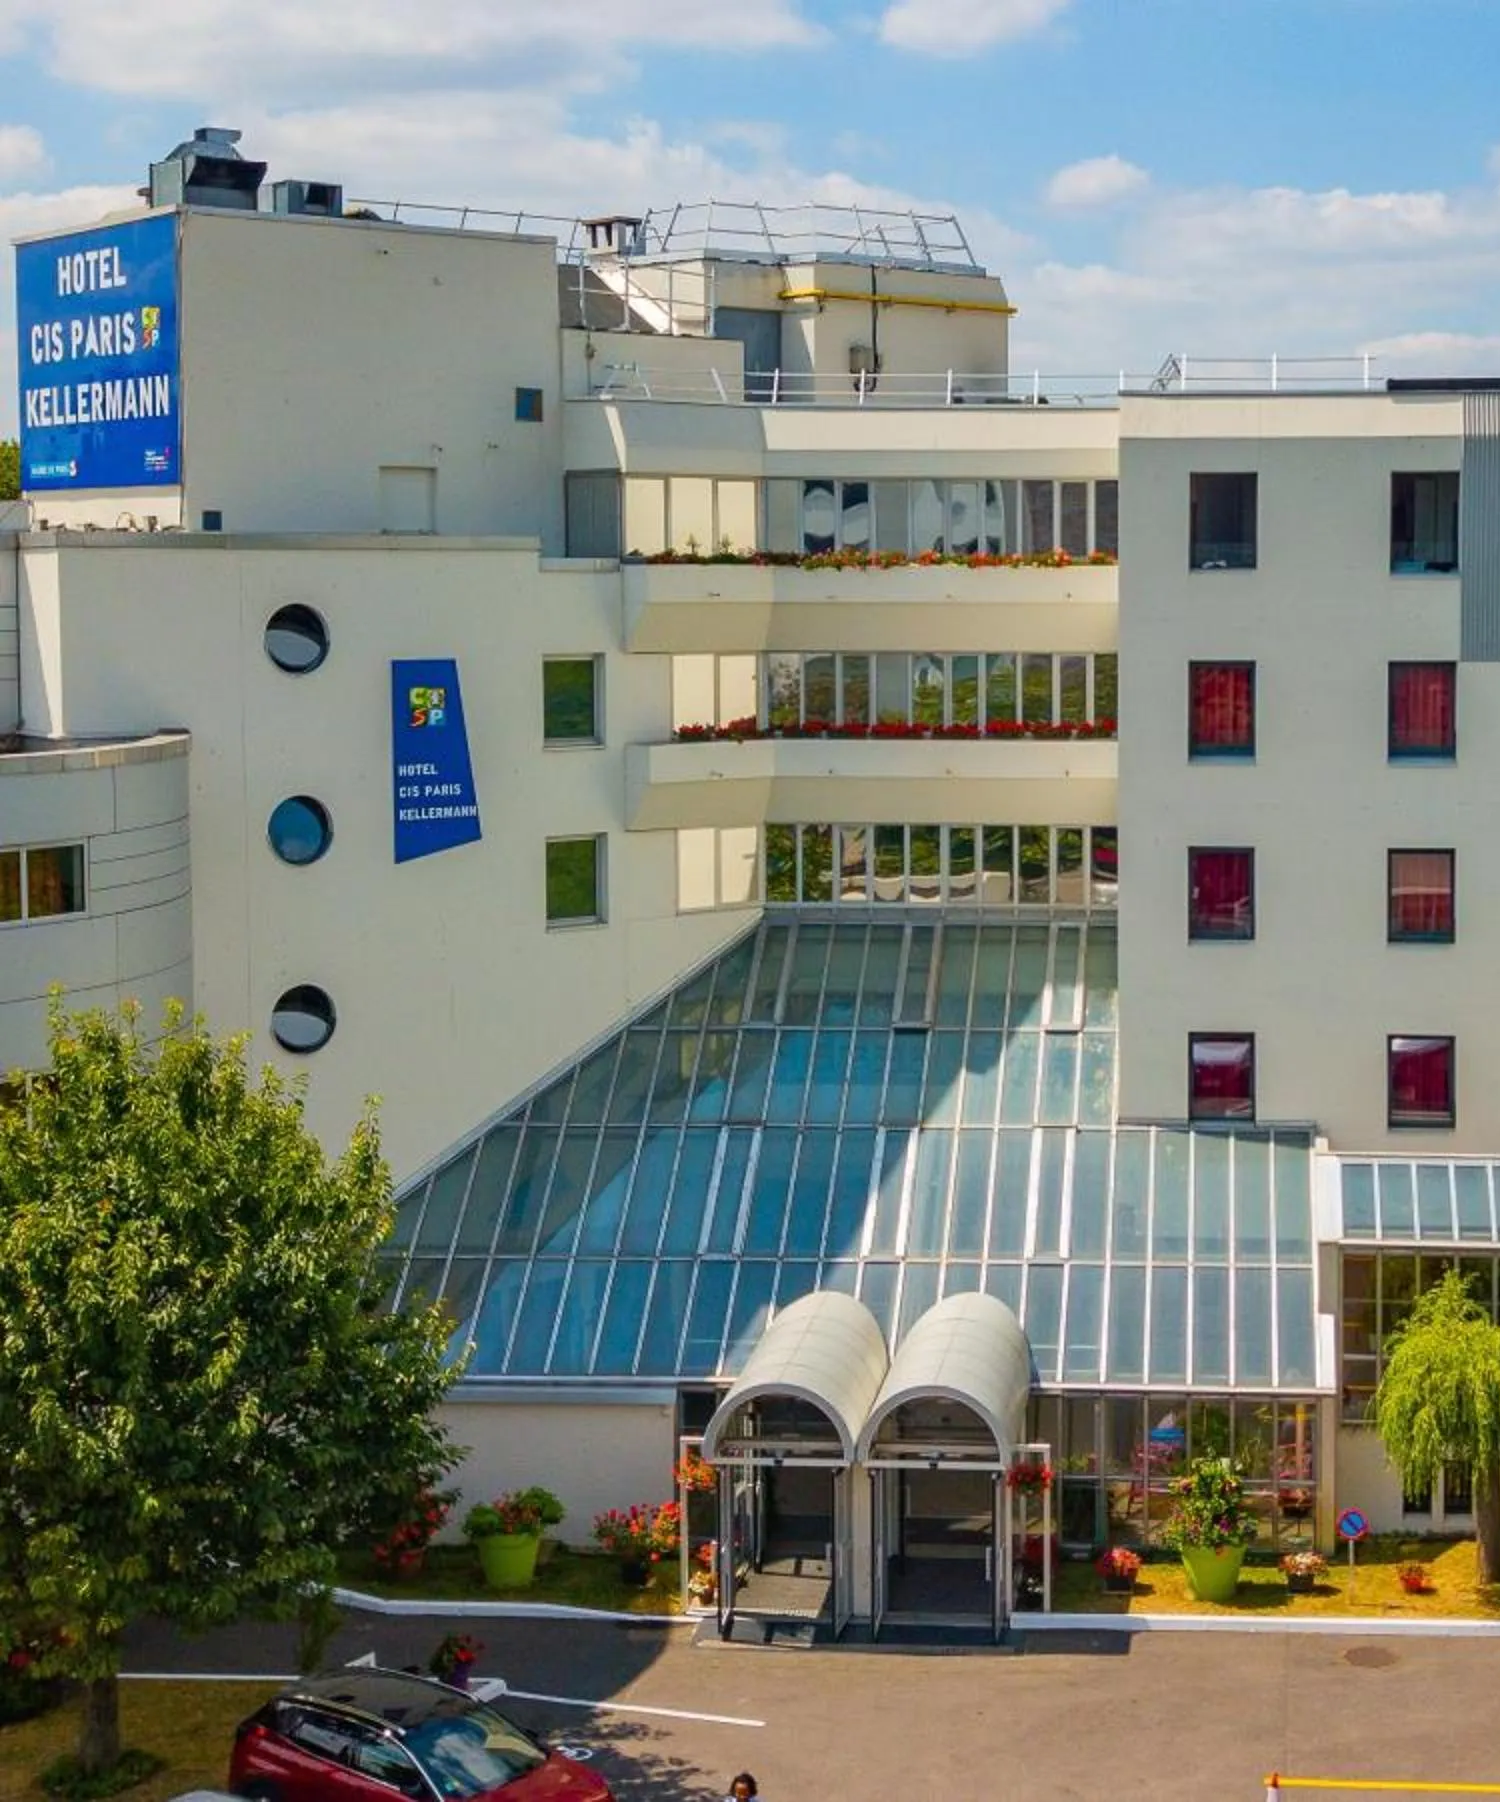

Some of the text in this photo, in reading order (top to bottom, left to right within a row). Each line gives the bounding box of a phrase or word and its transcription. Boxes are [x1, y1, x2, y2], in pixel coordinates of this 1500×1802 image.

[57, 247, 126, 296] HOTEL
[31, 311, 135, 364] CIS PARIS
[26, 374, 169, 428] KELLERMANN
[399, 763, 438, 776] HOTEL
[400, 784, 461, 798] CIS PARIS
[400, 805, 477, 820] KELLERMANN
